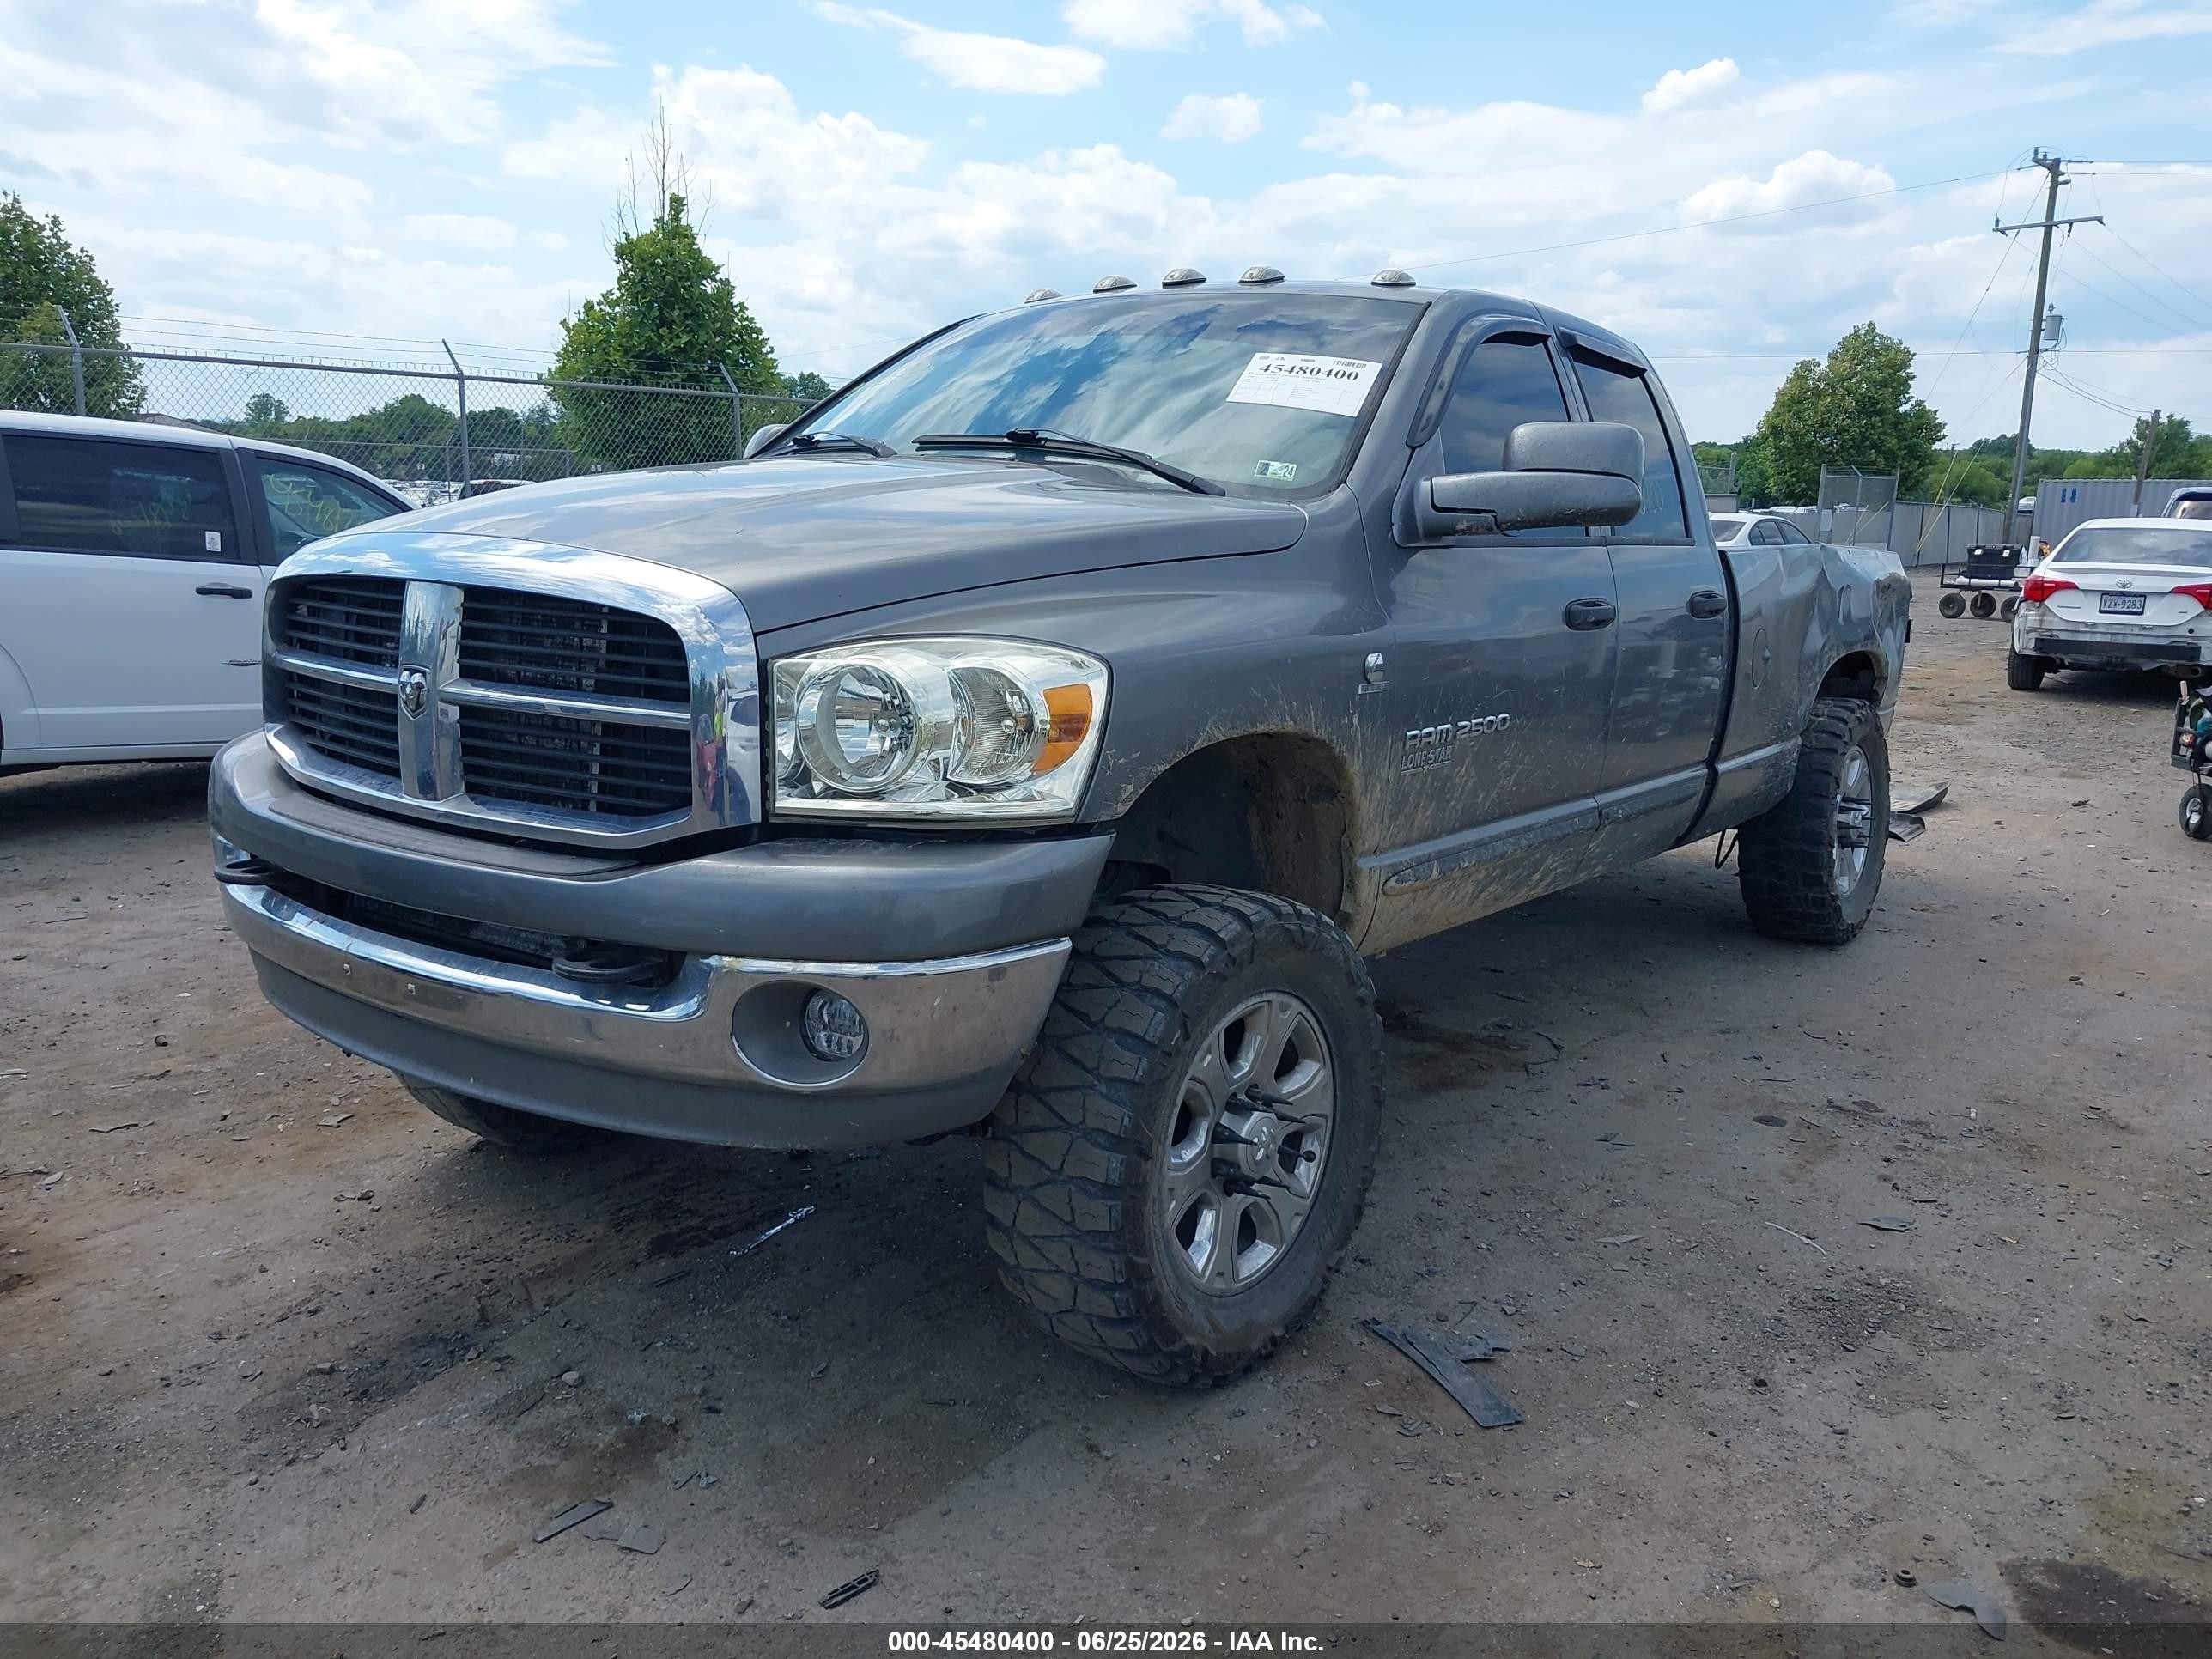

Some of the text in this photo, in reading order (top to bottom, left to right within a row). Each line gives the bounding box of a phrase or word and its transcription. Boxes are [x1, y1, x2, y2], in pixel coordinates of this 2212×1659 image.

[1259, 364, 1359, 381] 45480400
[1283, 465, 1295, 478] 24
[1405, 713, 1511, 750] RAM 2500
[1401, 745, 1453, 769] LONE STAR
